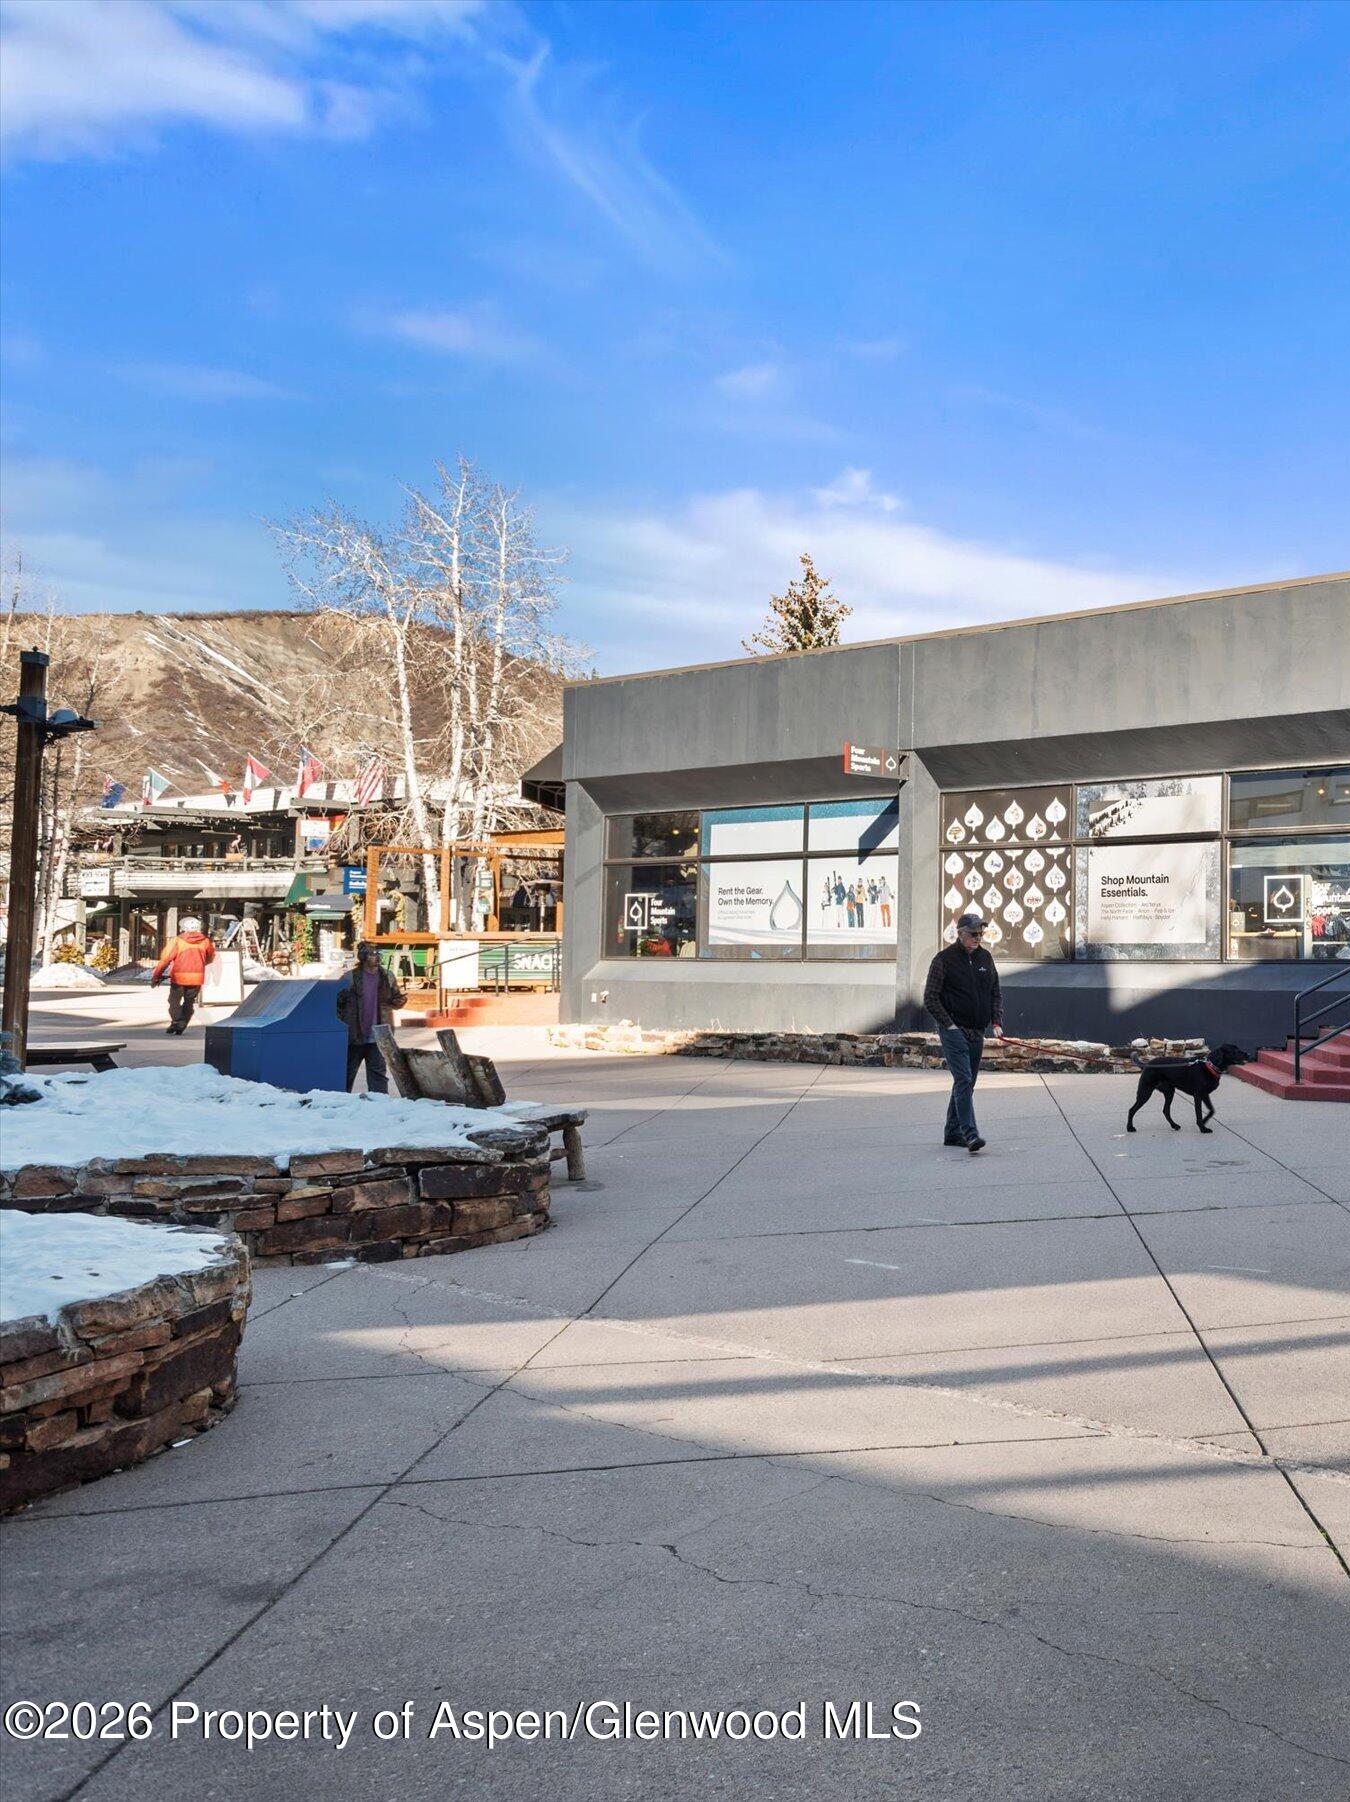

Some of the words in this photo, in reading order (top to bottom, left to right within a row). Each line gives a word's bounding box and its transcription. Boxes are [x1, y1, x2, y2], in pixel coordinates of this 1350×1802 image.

[851, 746, 866, 755] Four
[851, 754, 880, 765] Mountain
[851, 762, 872, 772] Sports
[1101, 876, 1124, 886] Shop
[1126, 874, 1170, 884] Mountain
[718, 887, 733, 895] Rent
[734, 886, 745, 894] the
[746, 886, 764, 895] Gear.
[1101, 887, 1148, 898] Essentials.
[651, 898, 663, 906] Four
[718, 898, 733, 906] Own
[734, 898, 745, 906] the
[651, 906, 675, 915] Mountain
[650, 916, 668, 926] Sports
